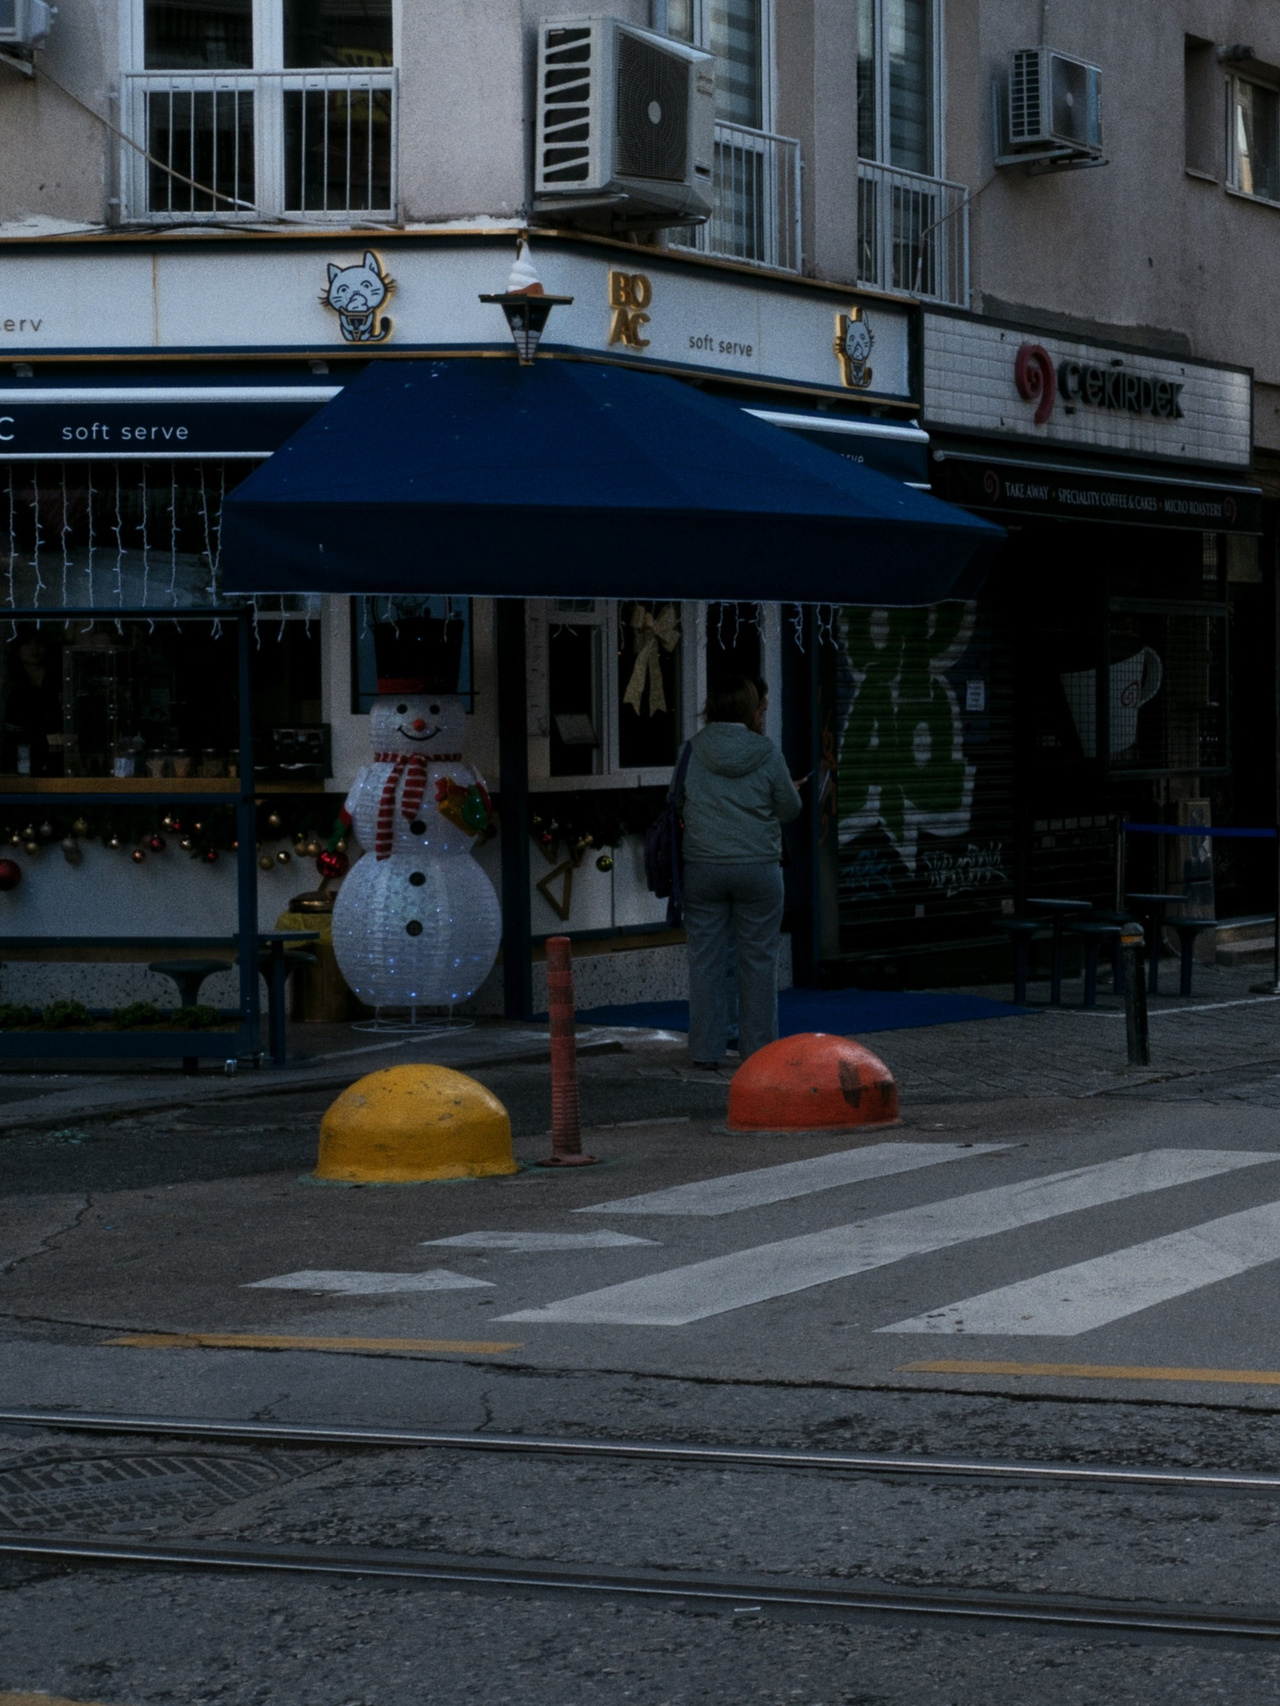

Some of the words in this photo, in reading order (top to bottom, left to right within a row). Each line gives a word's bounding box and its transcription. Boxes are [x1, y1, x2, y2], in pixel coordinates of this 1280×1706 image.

[610, 270, 652, 309] BO
[0, 318, 42, 332] erv
[689, 334, 714, 351] soft
[719, 340, 752, 356] serve
[61, 422, 110, 440] soft
[121, 426, 189, 440] serve
[1005, 481, 1025, 498] TAKE
[1025, 483, 1049, 500] AWAY
[1058, 488, 1100, 506] SPECIALITY
[1101, 492, 1128, 508] COFFEE
[1135, 495, 1157, 511] CAKES
